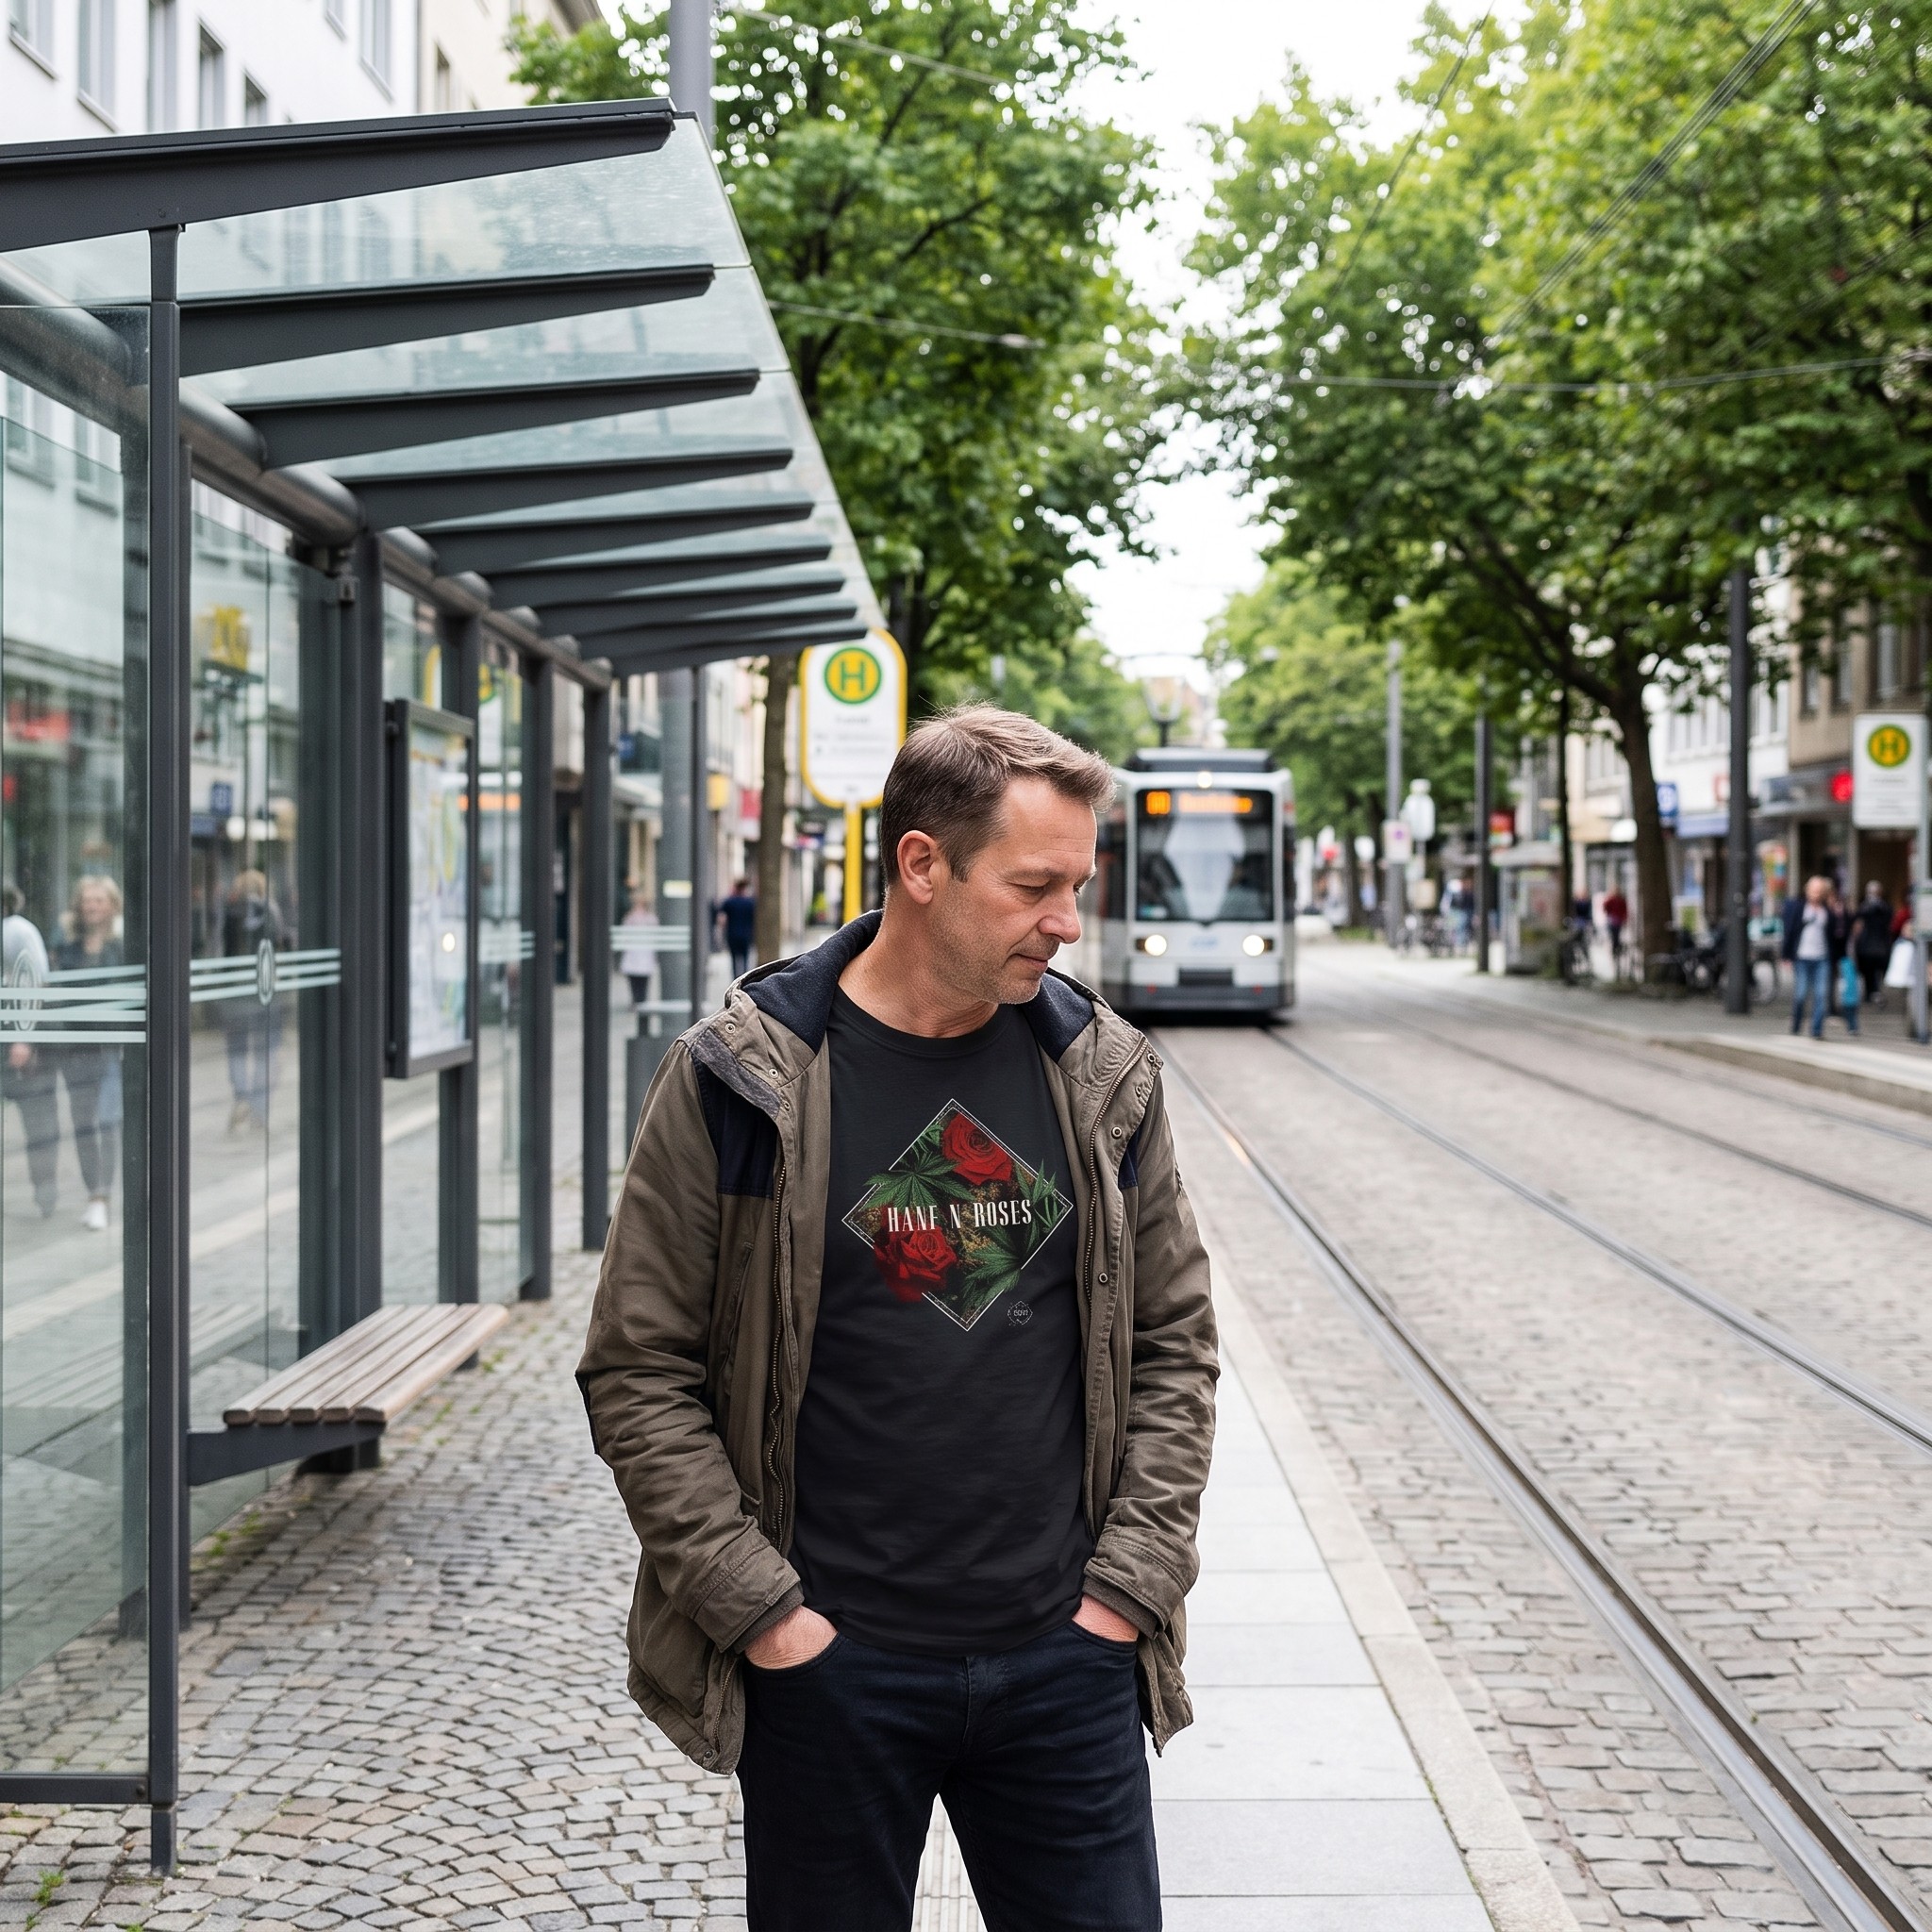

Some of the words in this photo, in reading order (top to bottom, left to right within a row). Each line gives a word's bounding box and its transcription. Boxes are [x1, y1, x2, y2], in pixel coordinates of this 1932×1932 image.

[840, 660, 866, 691] H
[1878, 736, 1899, 757] H
[888, 1205, 939, 1233] HANF
[949, 1204, 961, 1229] N
[973, 1199, 1032, 1228] ROSES
